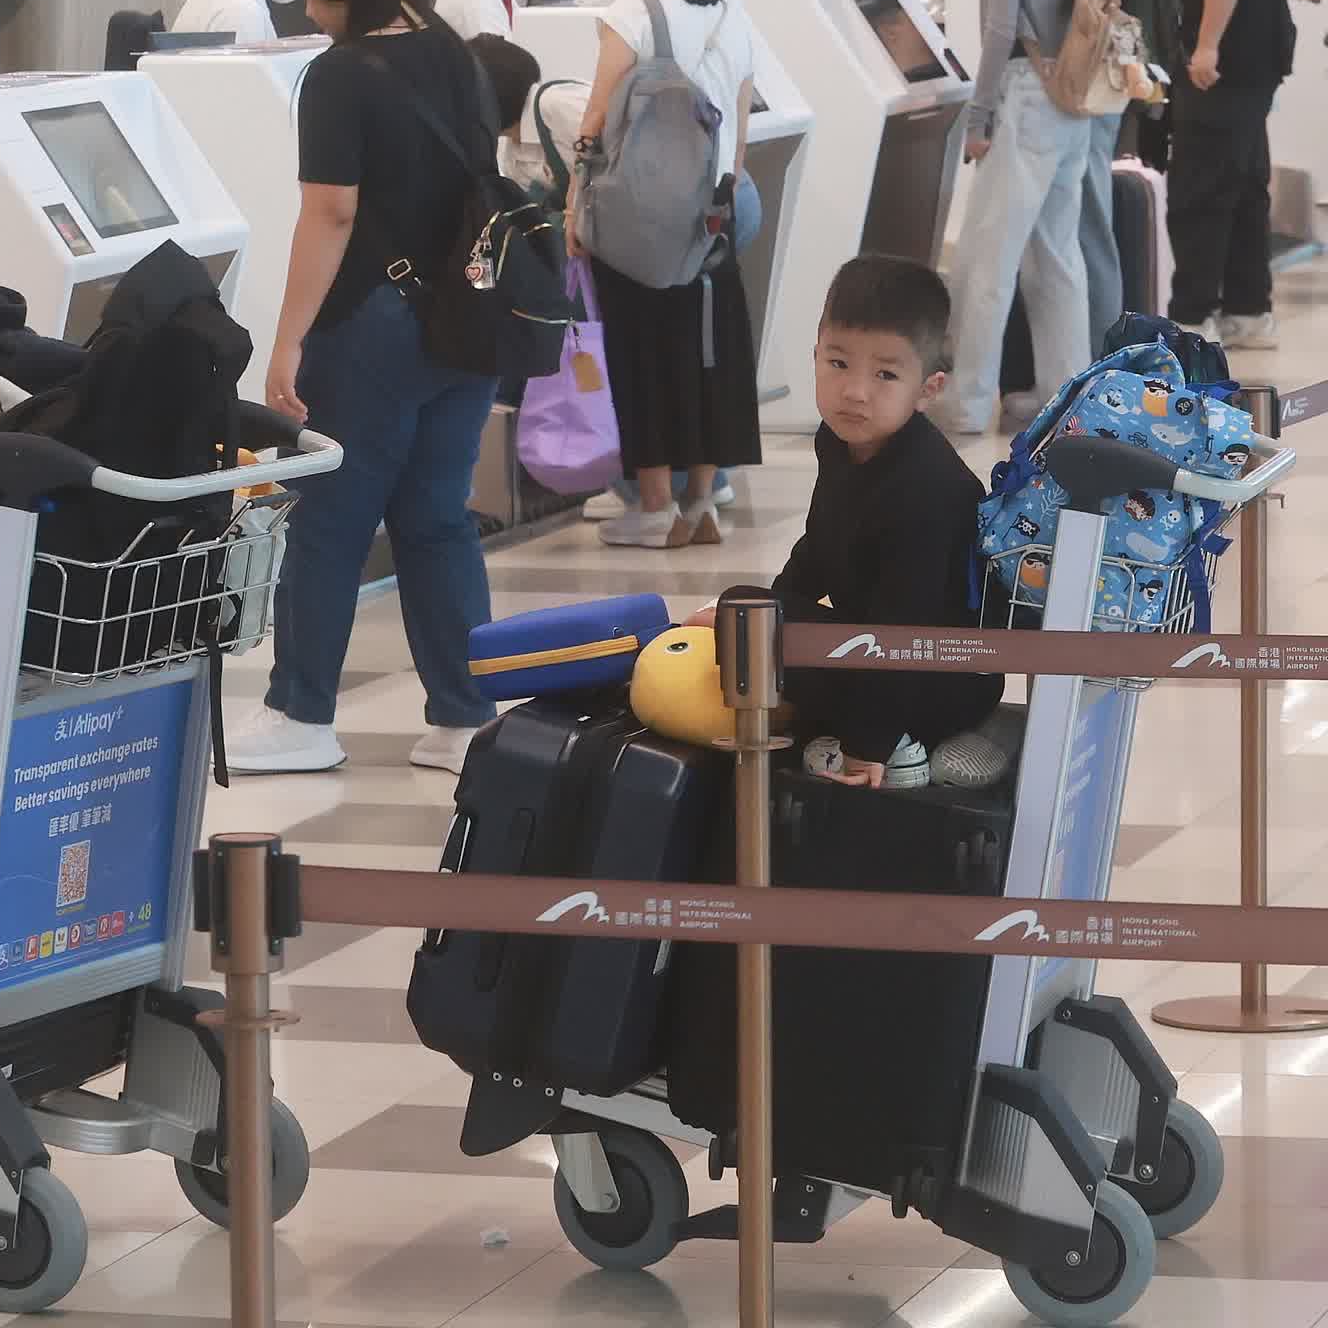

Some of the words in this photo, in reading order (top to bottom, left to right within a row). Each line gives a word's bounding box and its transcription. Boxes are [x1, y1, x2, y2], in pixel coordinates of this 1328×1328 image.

[14, 754, 80, 784] Transparent
[79, 745, 131, 770] exchange
[132, 736, 159, 754] rates
[14, 791, 49, 812] Better
[48, 782, 90, 801] savings
[90, 766, 152, 792] everywhere
